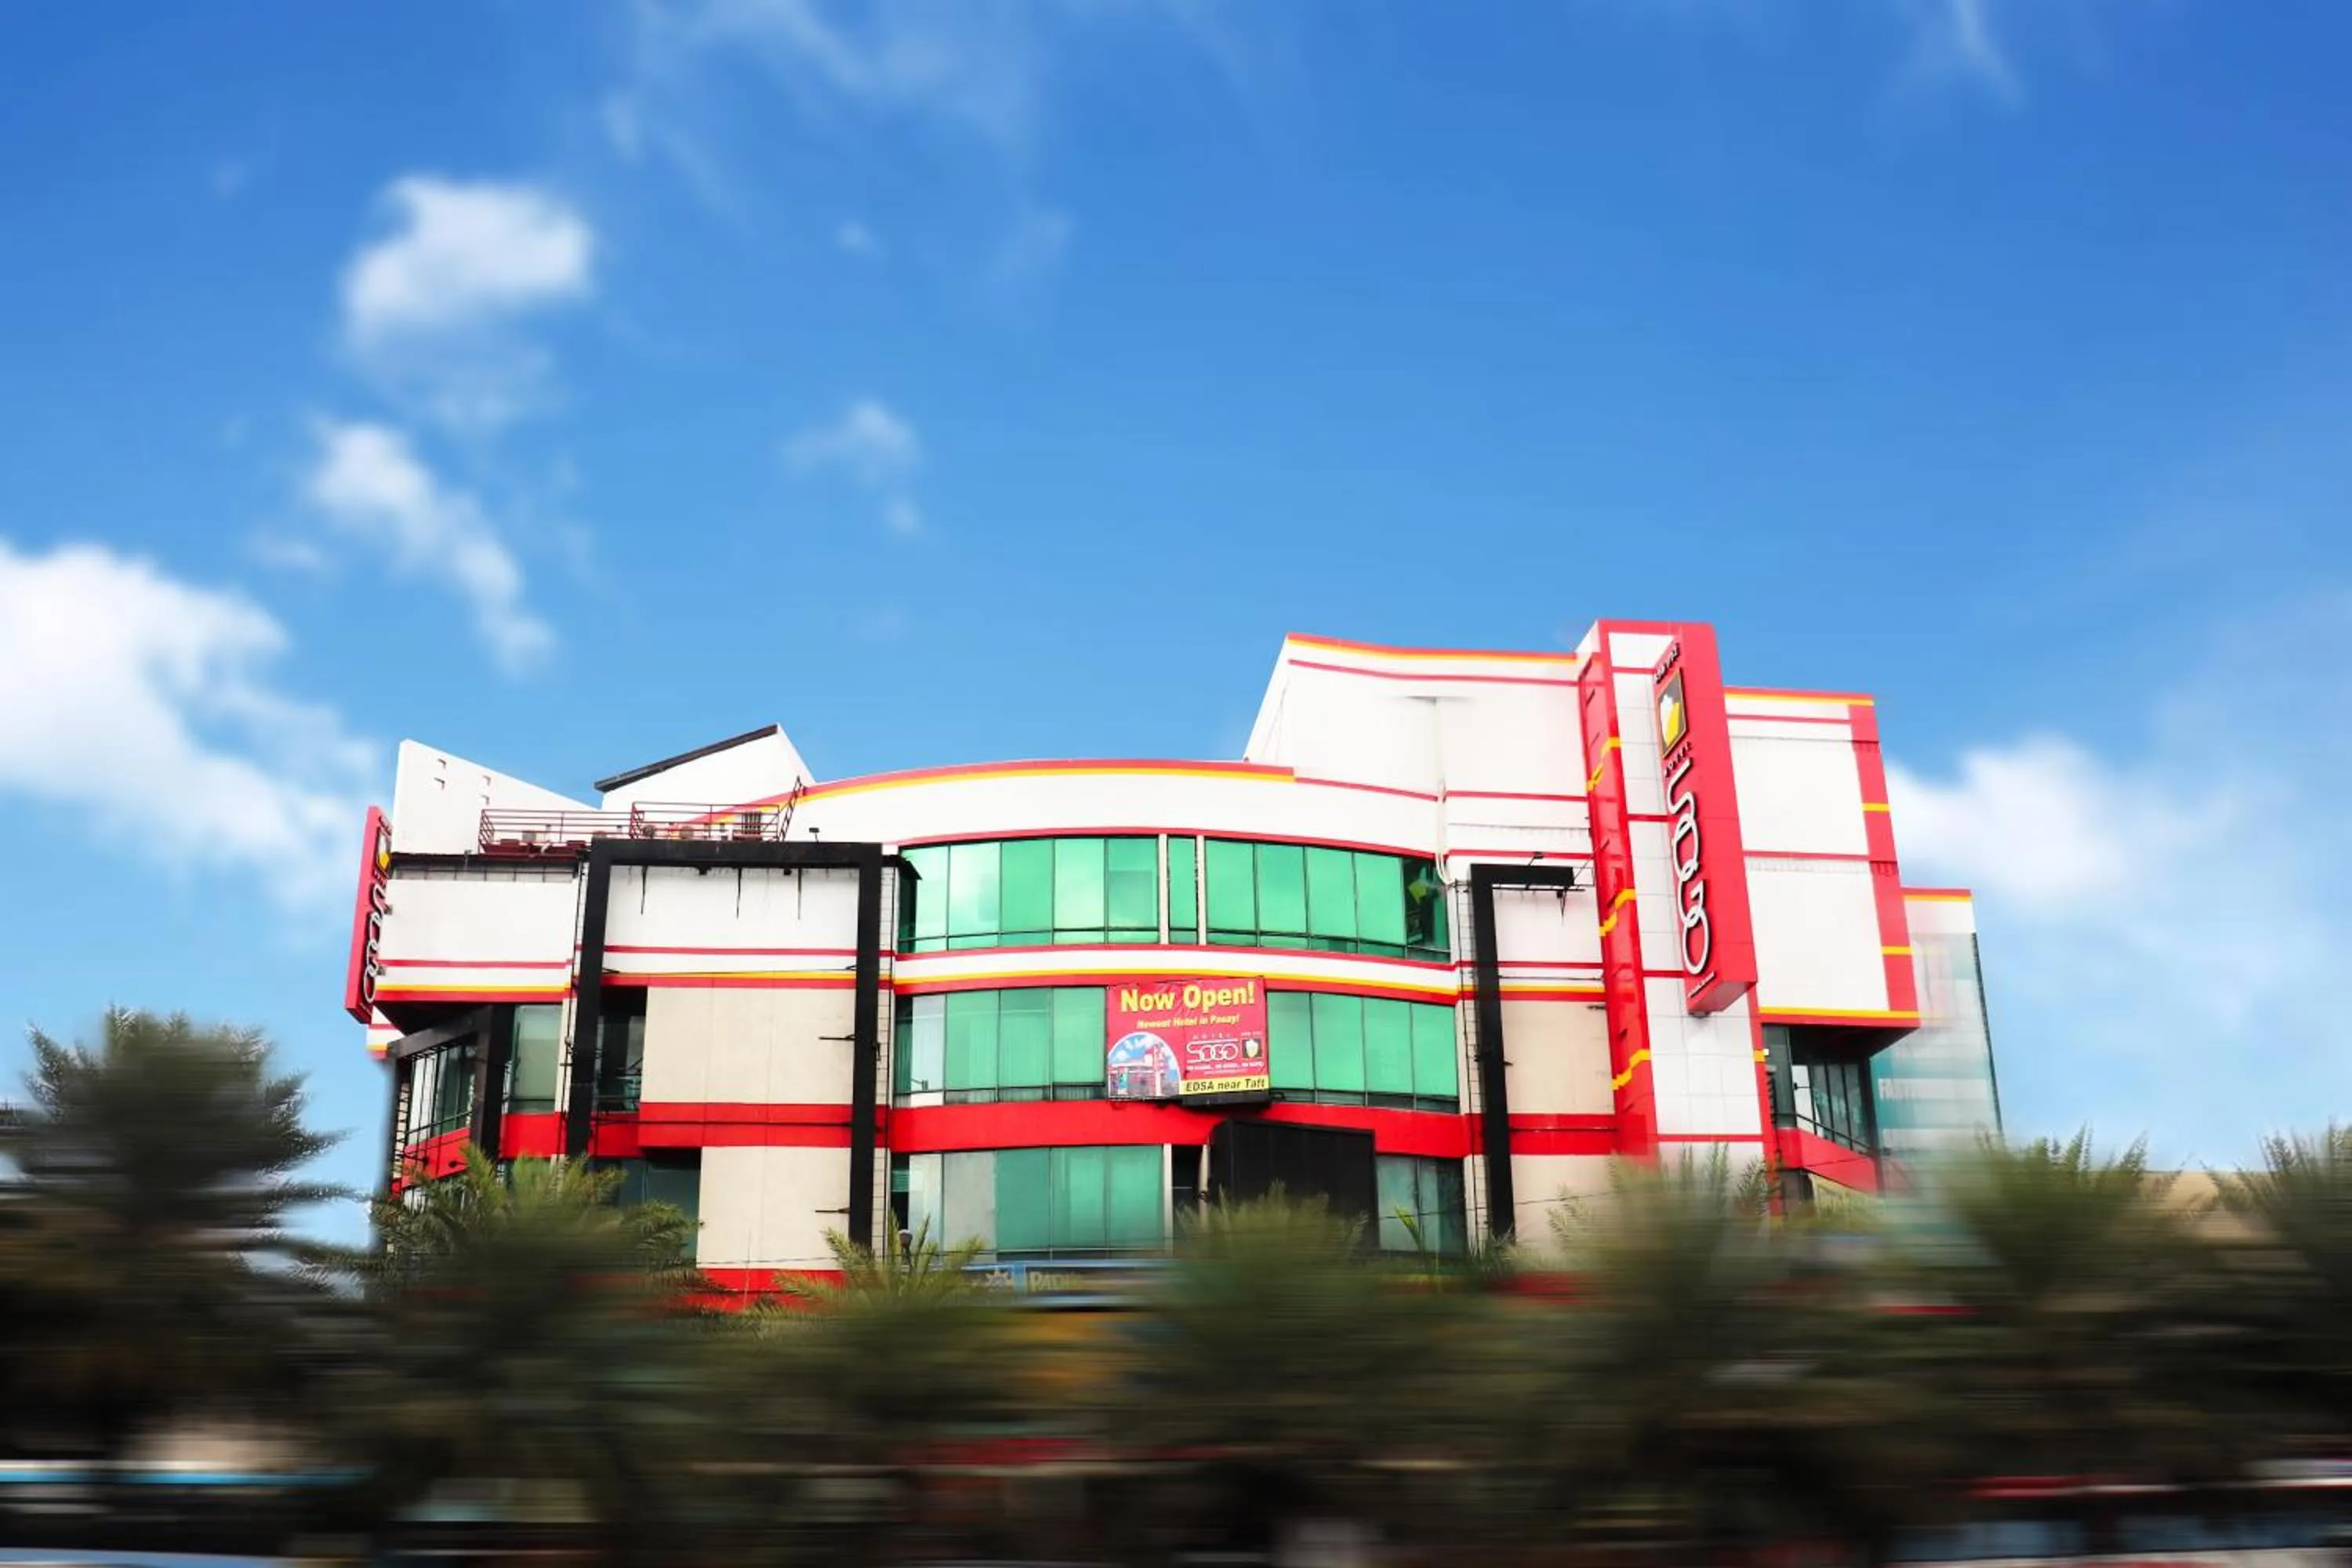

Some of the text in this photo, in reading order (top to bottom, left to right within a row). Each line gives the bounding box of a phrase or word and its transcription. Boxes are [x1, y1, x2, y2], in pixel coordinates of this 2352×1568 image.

[1120, 981, 1254, 1013] Now Open!
[1186, 1039, 1238, 1063] SOGO
[1185, 1077, 1265, 1092] EDSA near Taft
